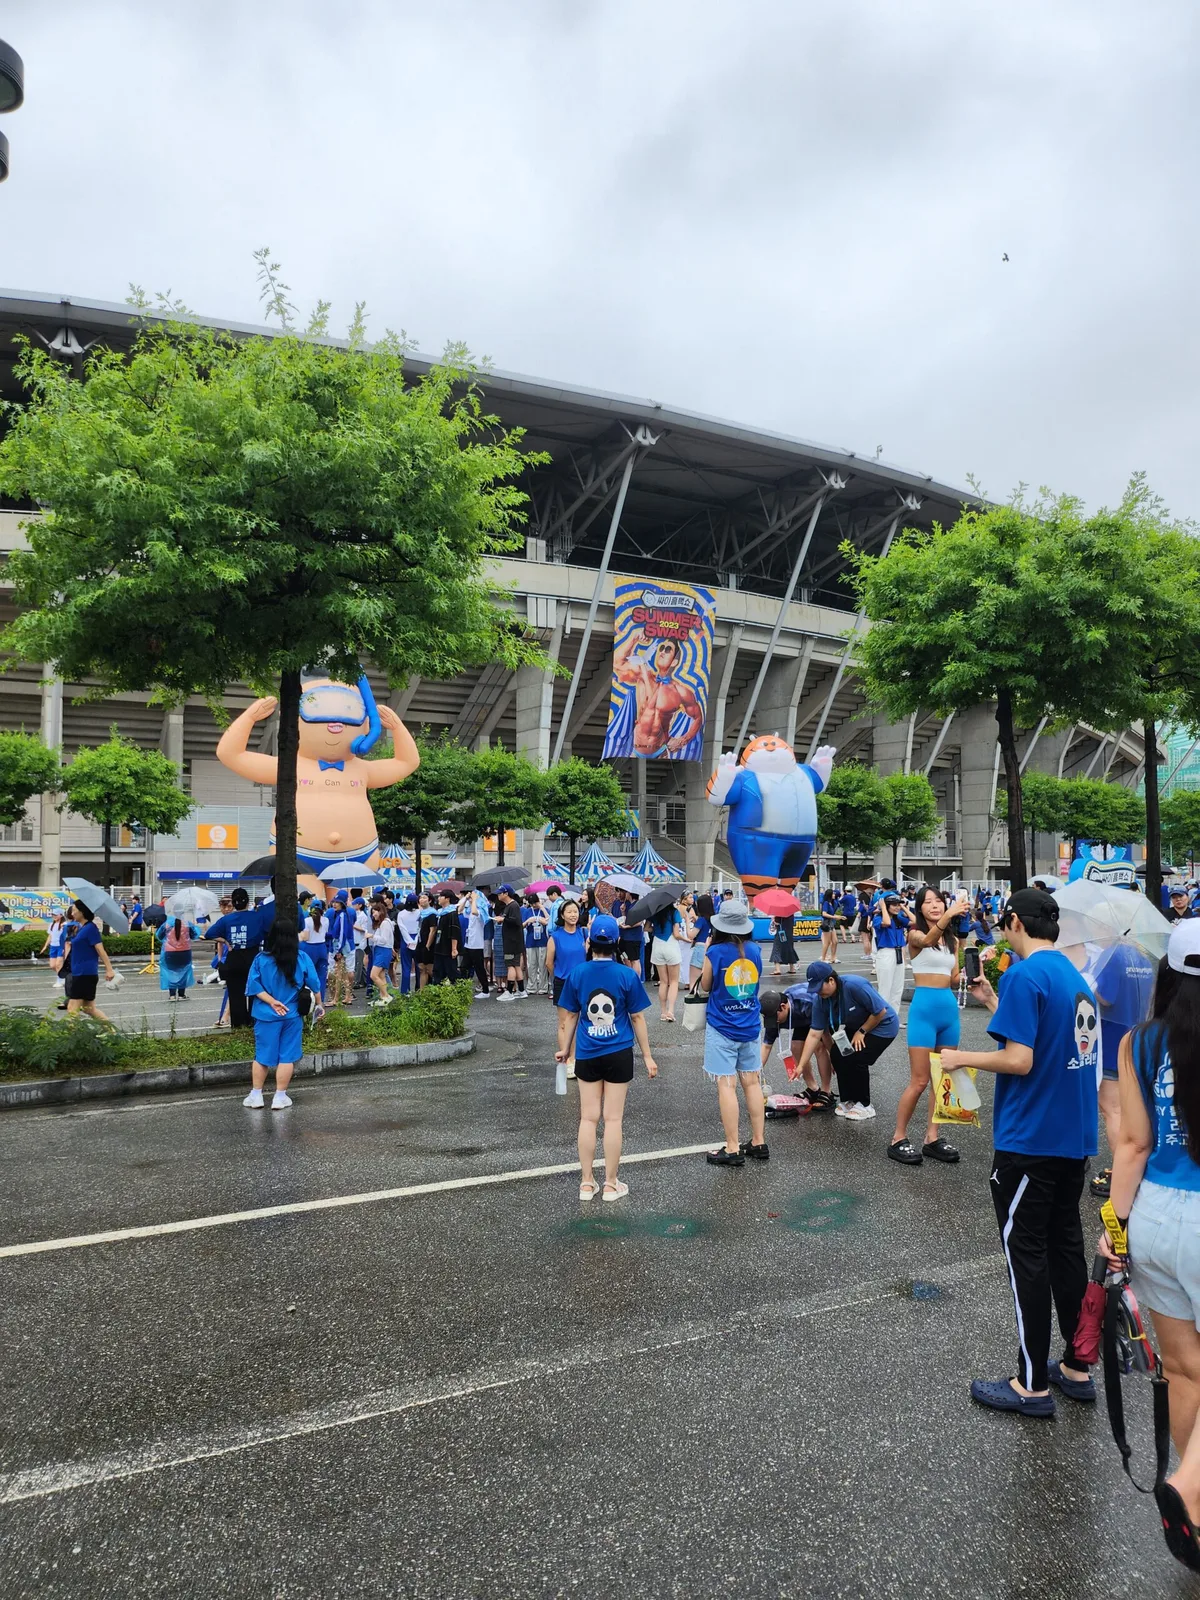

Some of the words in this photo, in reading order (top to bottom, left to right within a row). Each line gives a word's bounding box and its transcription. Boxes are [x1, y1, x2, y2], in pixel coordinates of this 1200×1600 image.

[632, 607, 702, 629] SUMMER
[659, 620, 680, 630] 2023
[645, 623, 689, 641] SWAG
[324, 778, 341, 787] Can
[792, 928, 819, 937] SWAG
